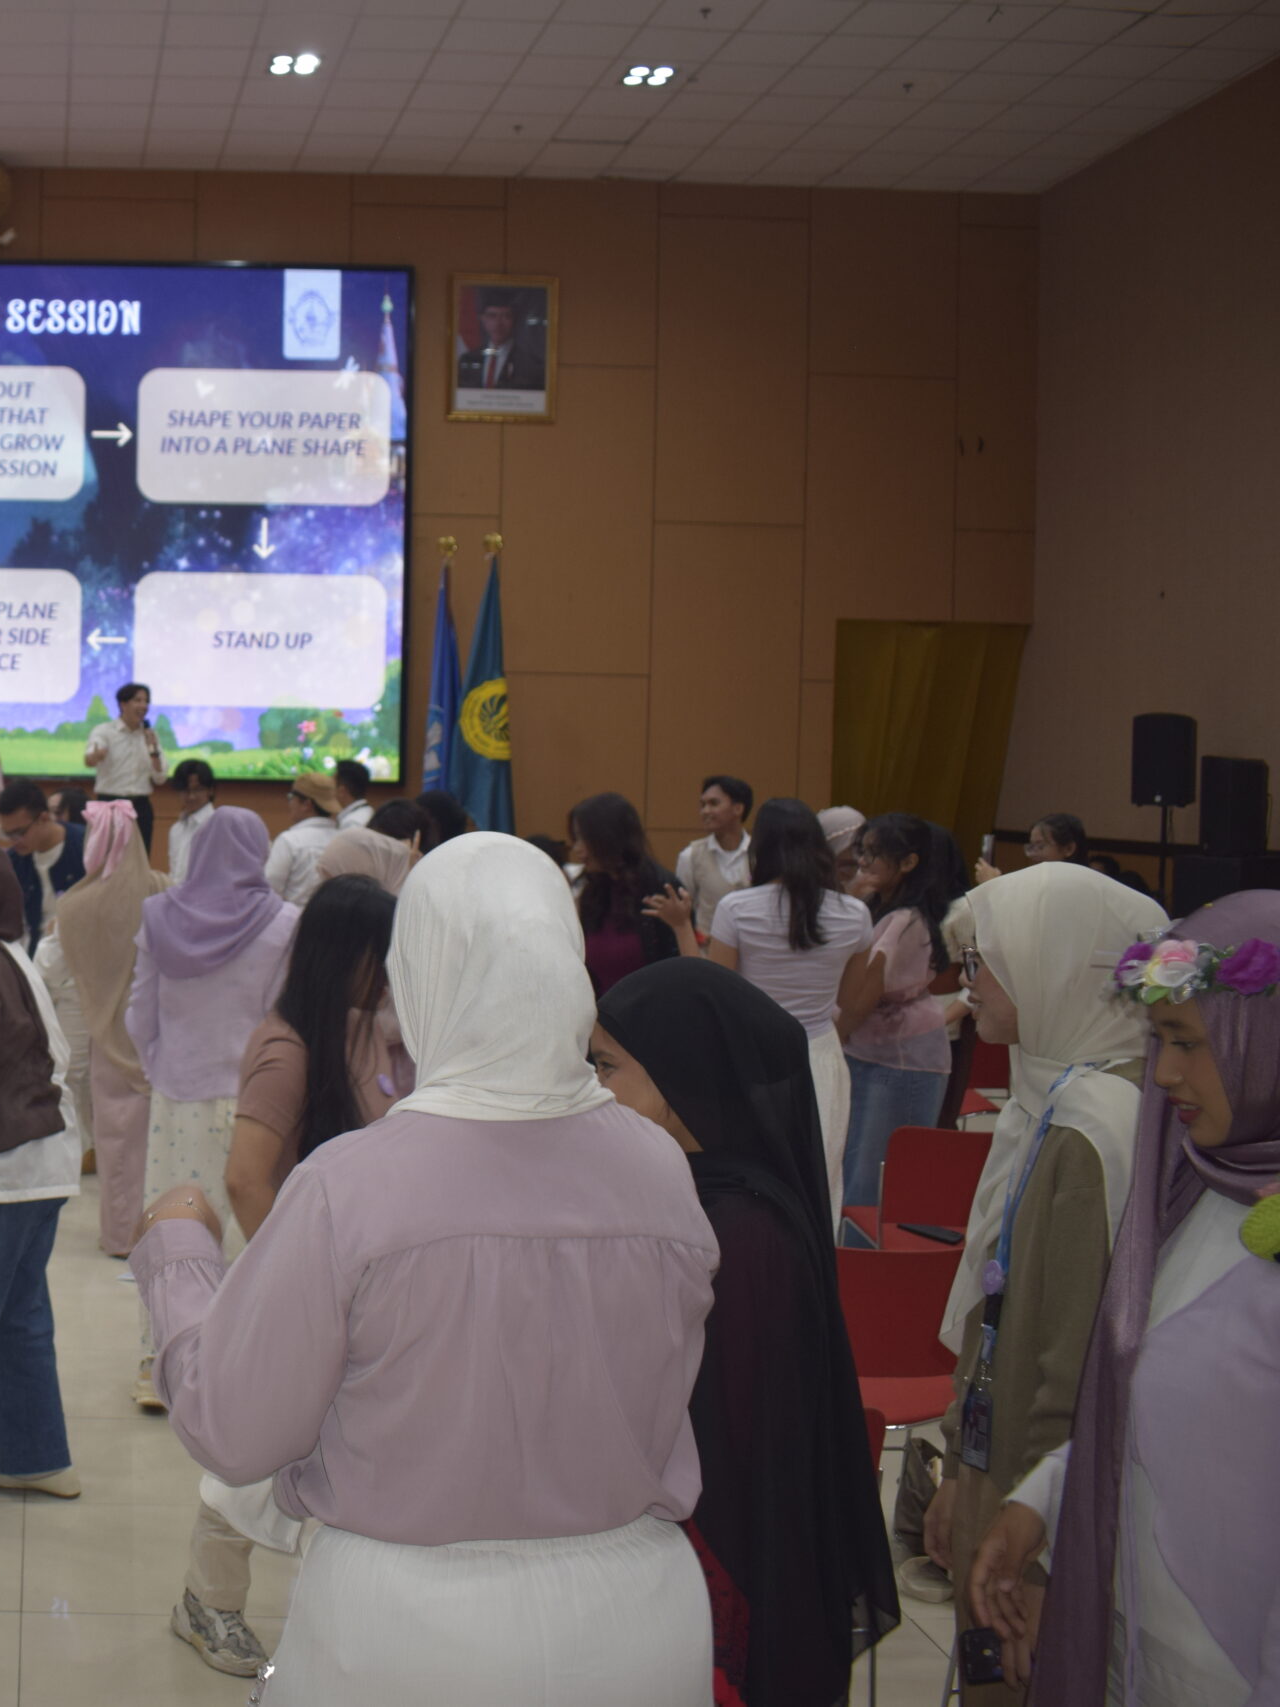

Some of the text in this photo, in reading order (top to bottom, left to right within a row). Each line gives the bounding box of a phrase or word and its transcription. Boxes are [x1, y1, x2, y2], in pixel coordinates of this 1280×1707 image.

[6, 298, 141, 335] SESSION
[167, 410, 361, 430] SHAPE YOUR PAPER
[3, 434, 64, 451] GROW
[160, 437, 367, 456] INTO A PLANE SHAPE
[9, 628, 52, 645] SIDE
[213, 631, 313, 650] STAND UP
